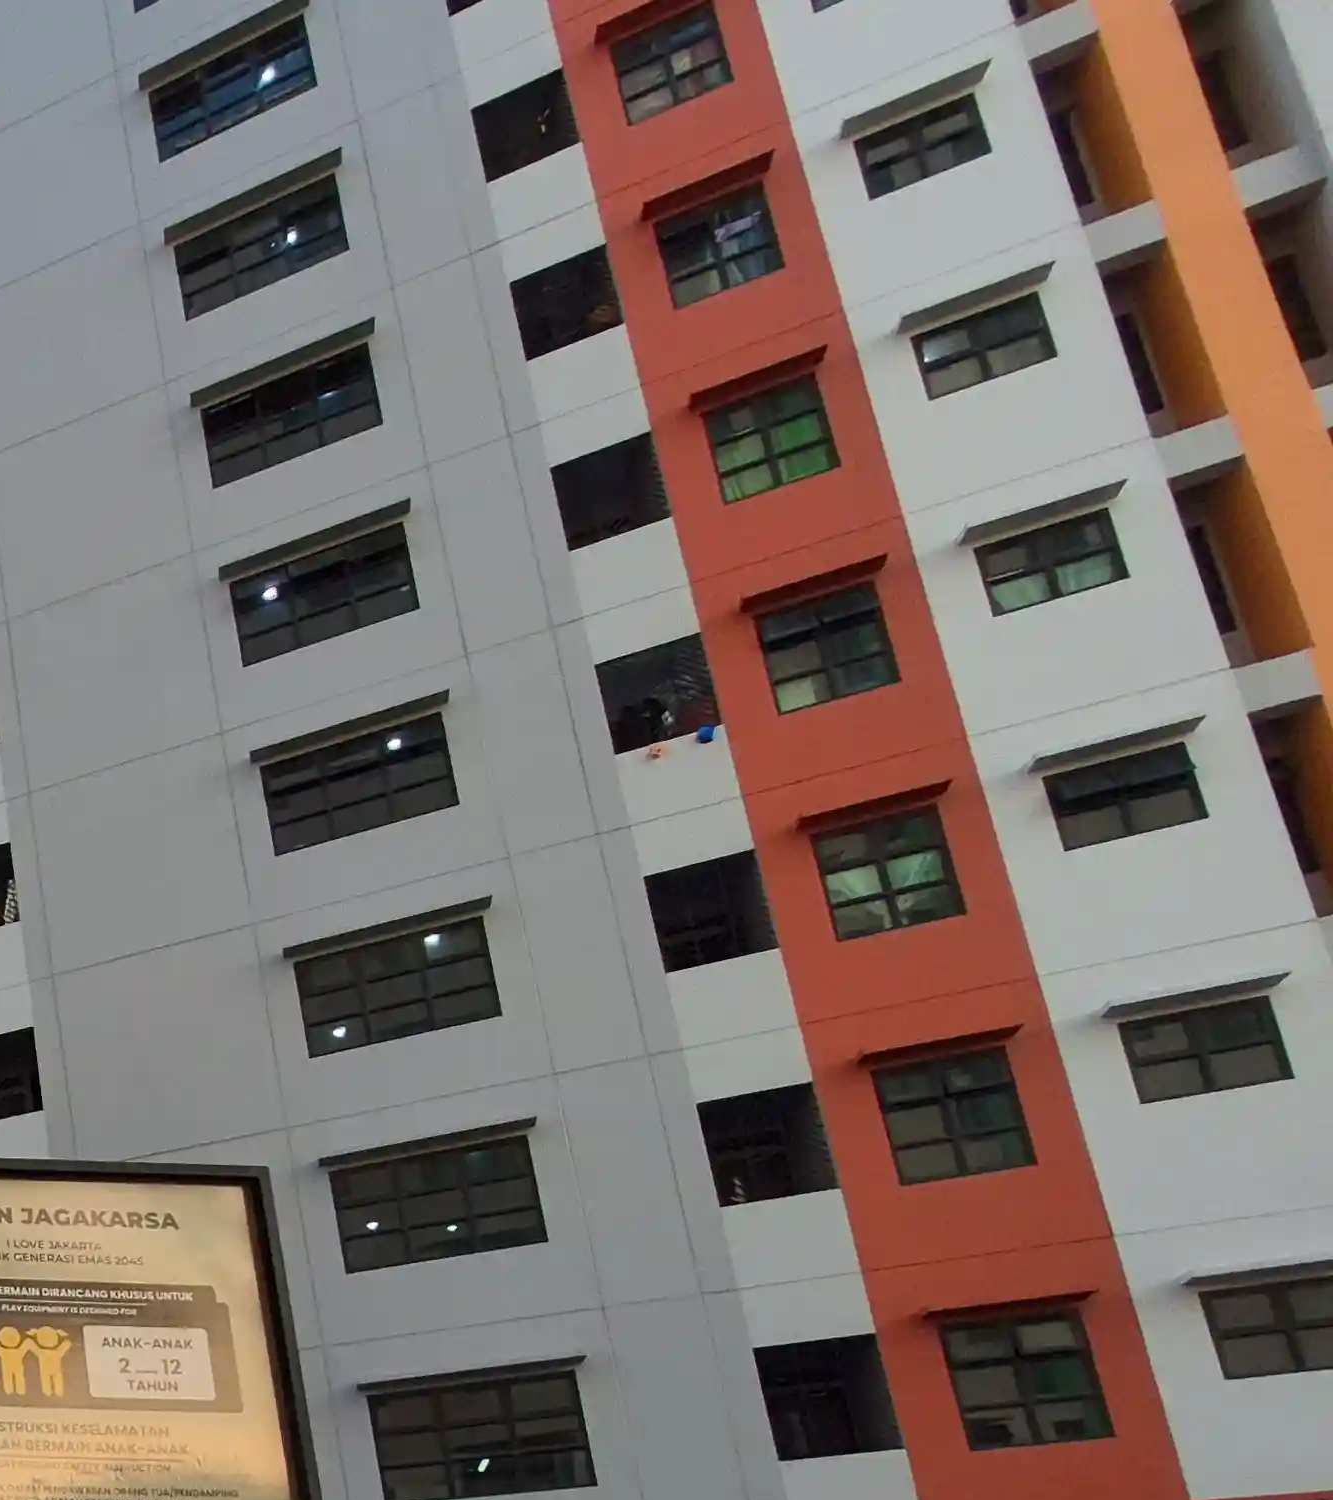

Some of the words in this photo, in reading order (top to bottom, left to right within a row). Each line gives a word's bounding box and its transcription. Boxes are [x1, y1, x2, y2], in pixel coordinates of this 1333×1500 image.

[21, 1207, 180, 1231] JAGAKARSA
[13, 1239, 45, 1249] LOVE
[48, 1240, 103, 1251] JAKARTA
[13, 1252, 75, 1264] GENERASI
[77, 1255, 112, 1265] EMAS
[41, 1287, 108, 1298] DIRANCANG
[110, 1290, 154, 1300] KHUSUS
[155, 1291, 194, 1301] UNTUK
[1, 1304, 22, 1312] PLAY
[101, 1336, 194, 1350] ANAK-ANAK
[118, 1357, 131, 1374] 2
[161, 1359, 183, 1375] 12
[127, 1379, 179, 1392] TAHUN
[62, 1423, 170, 1437] KESELAMATAN
[25, 1439, 90, 1452] BERMAIN
[94, 1441, 190, 1455] ANAK-ANAK
